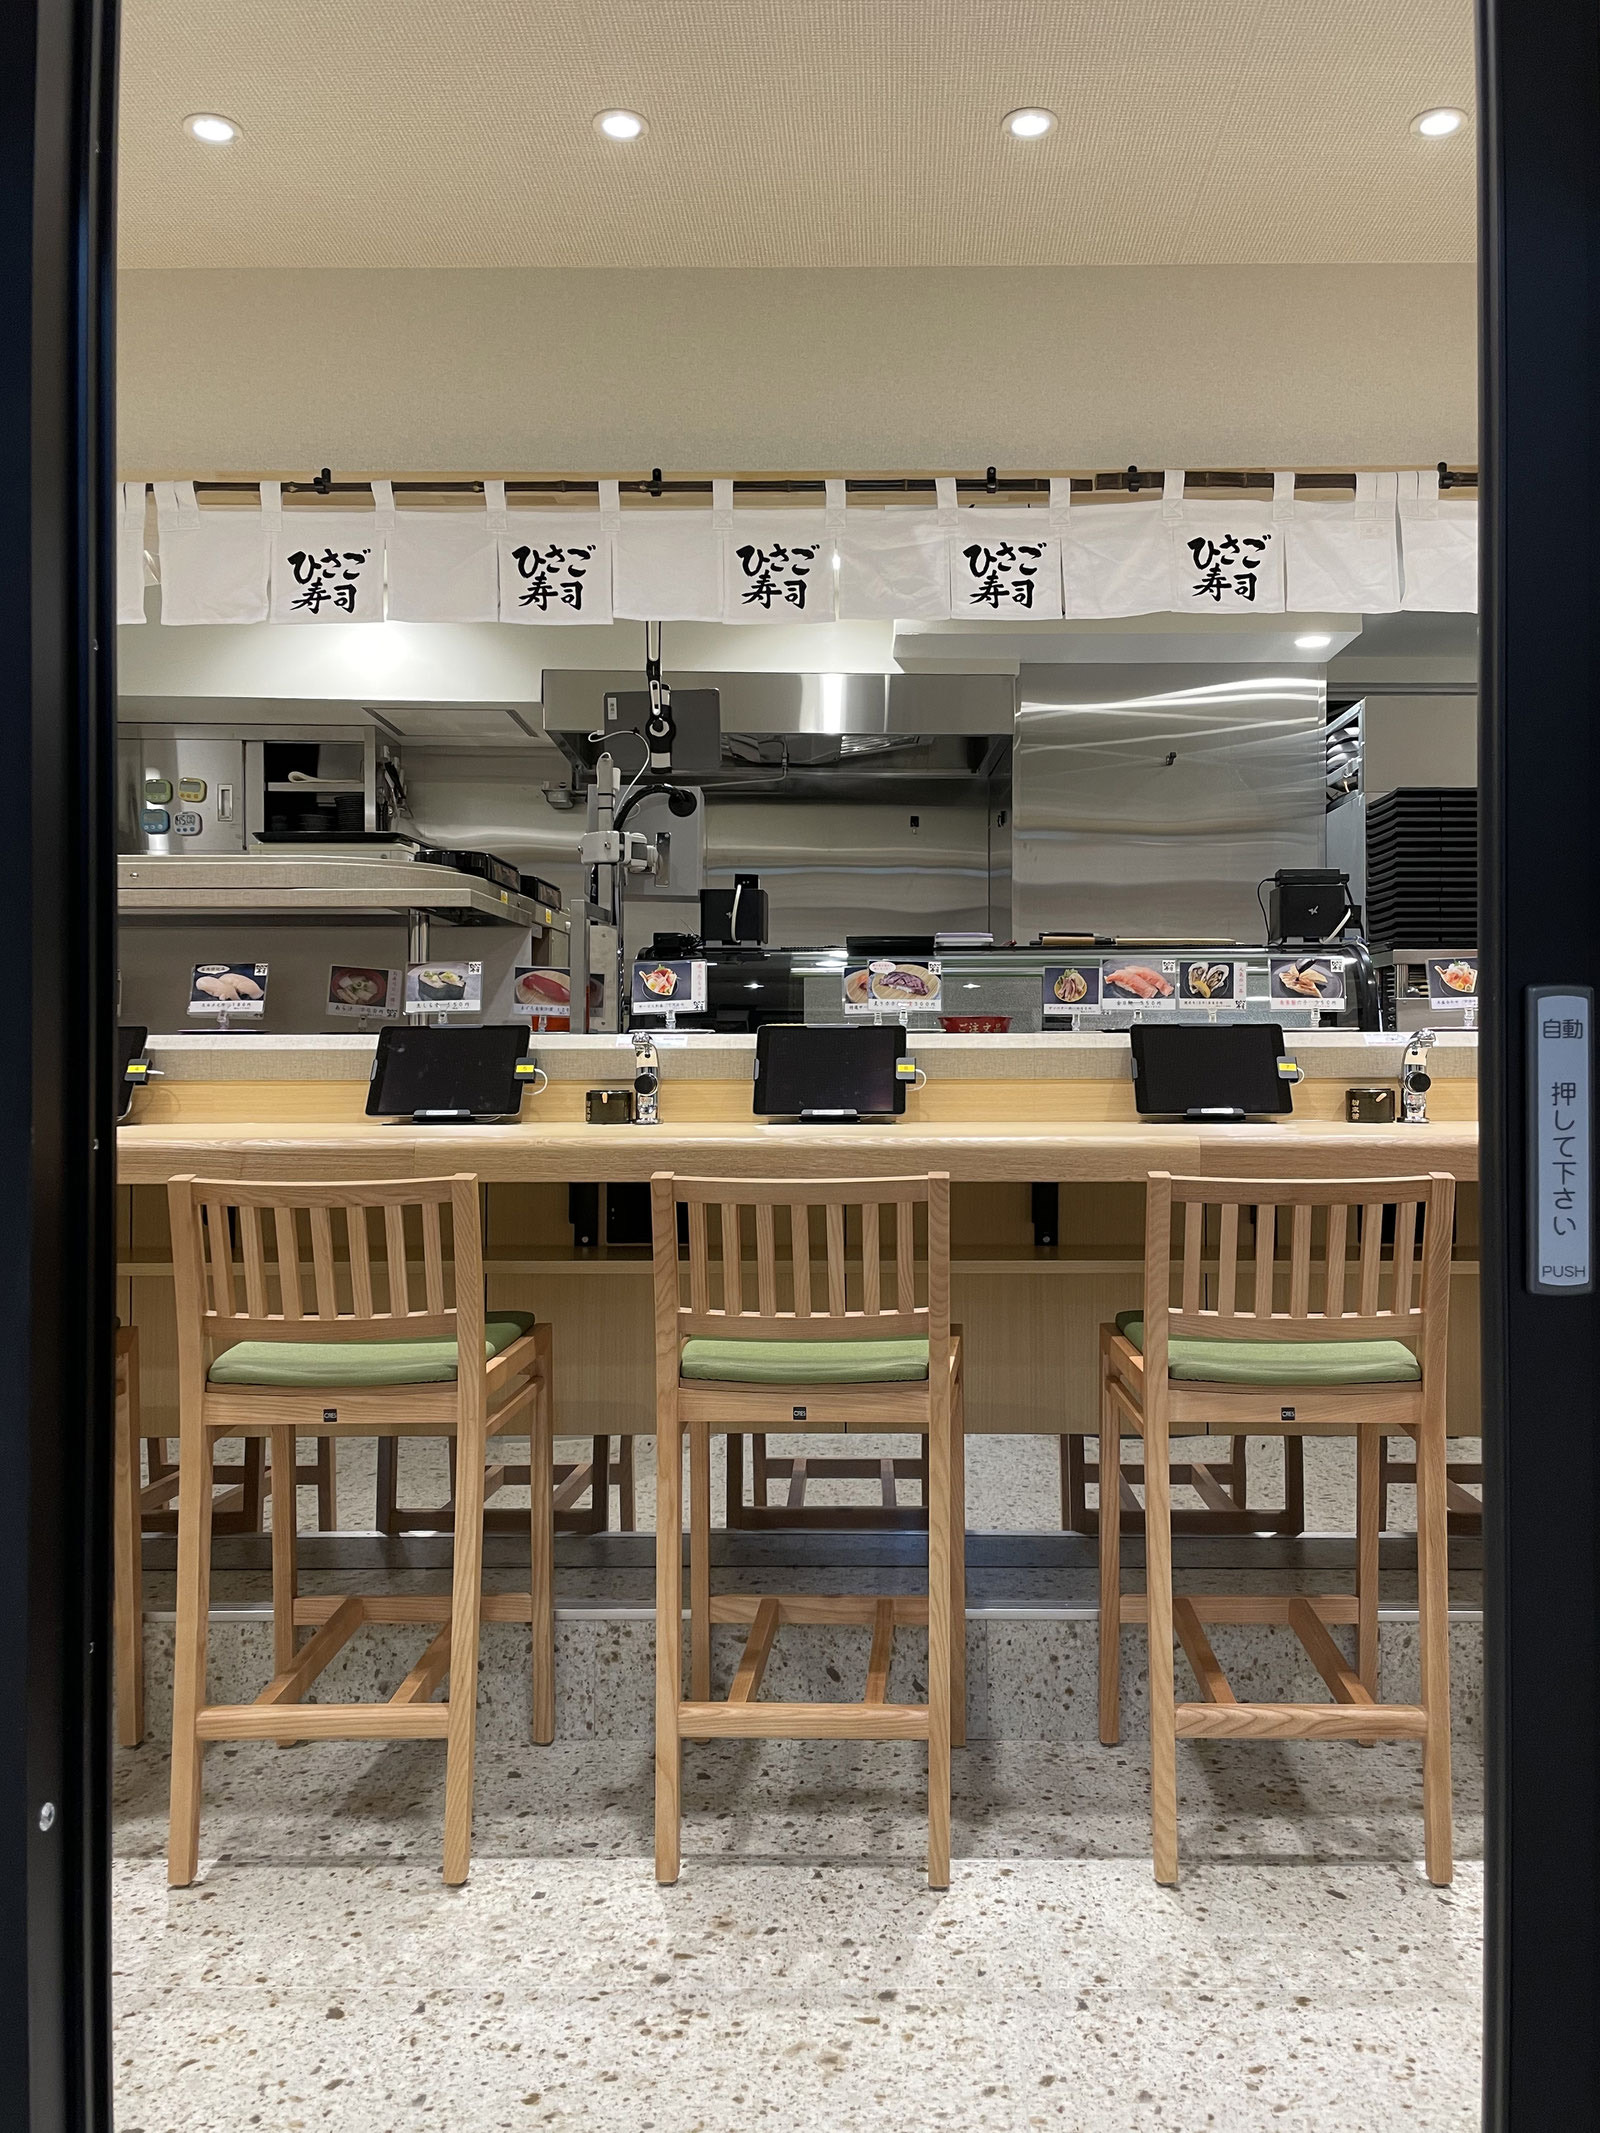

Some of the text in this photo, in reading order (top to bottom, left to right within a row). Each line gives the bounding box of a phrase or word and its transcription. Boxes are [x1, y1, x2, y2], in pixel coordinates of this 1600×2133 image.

[288, 548, 371, 585] ひさご
[512, 544, 597, 580] ひさご
[736, 544, 821, 577] ひさご
[963, 542, 1047, 577] ひさご
[1187, 534, 1272, 570] ひさご
[290, 577, 357, 614] 寿司
[519, 571, 584, 611] 寿司
[742, 569, 807, 609] 寿司
[969, 569, 1035, 608] 寿司
[1192, 563, 1258, 602] 寿司
[1542, 1018, 1584, 1040] 自動
[1551, 1082, 1577, 1236] 押して下さい
[1541, 1265, 1587, 1279] PUSH
